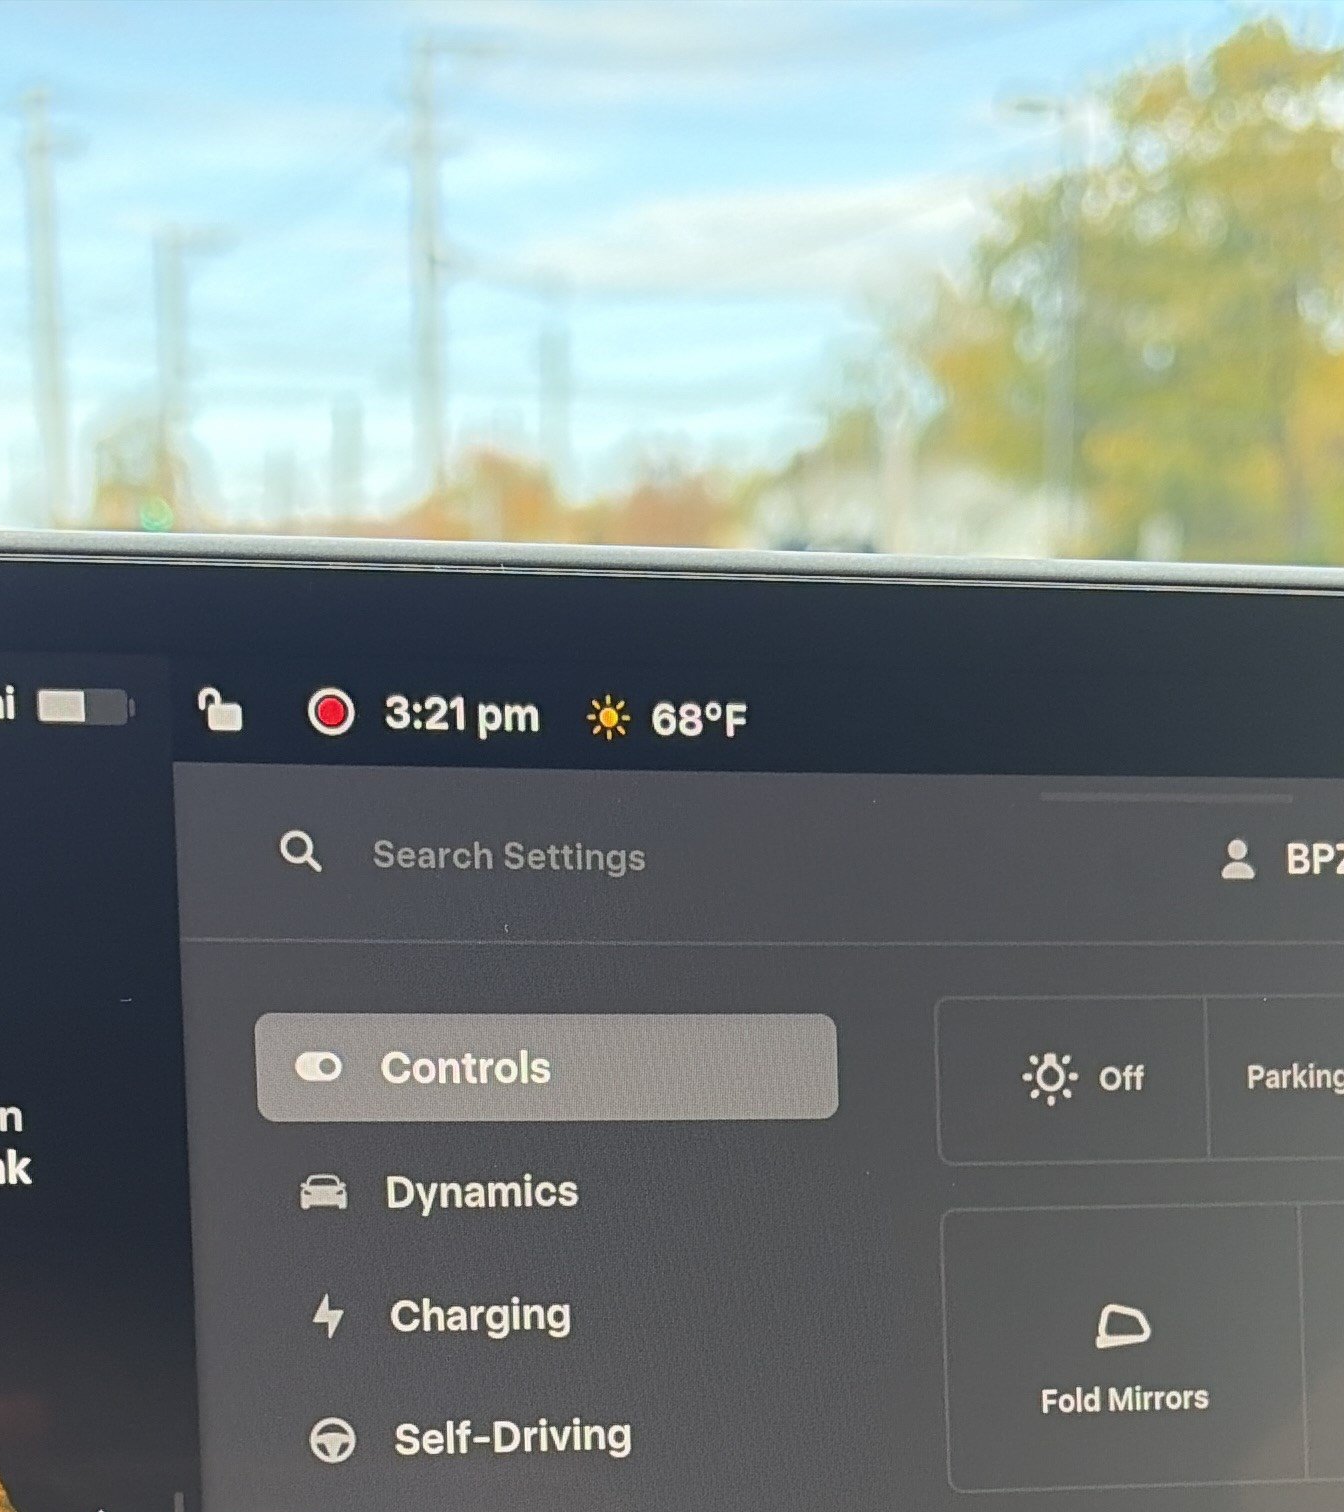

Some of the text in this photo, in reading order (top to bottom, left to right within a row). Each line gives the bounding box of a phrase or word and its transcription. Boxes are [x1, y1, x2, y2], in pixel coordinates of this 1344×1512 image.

[385, 694, 540, 740] 3:21 pm
[652, 701, 748, 738] 68°F
[373, 839, 646, 878] Search Settings
[380, 1049, 551, 1085] Controls
[1099, 1064, 1145, 1091] Off
[386, 1173, 579, 1217] Dynamics
[390, 1296, 571, 1340] Charging
[1041, 1385, 1210, 1414] Fold Mirrors
[395, 1417, 632, 1459] Self-Driving
